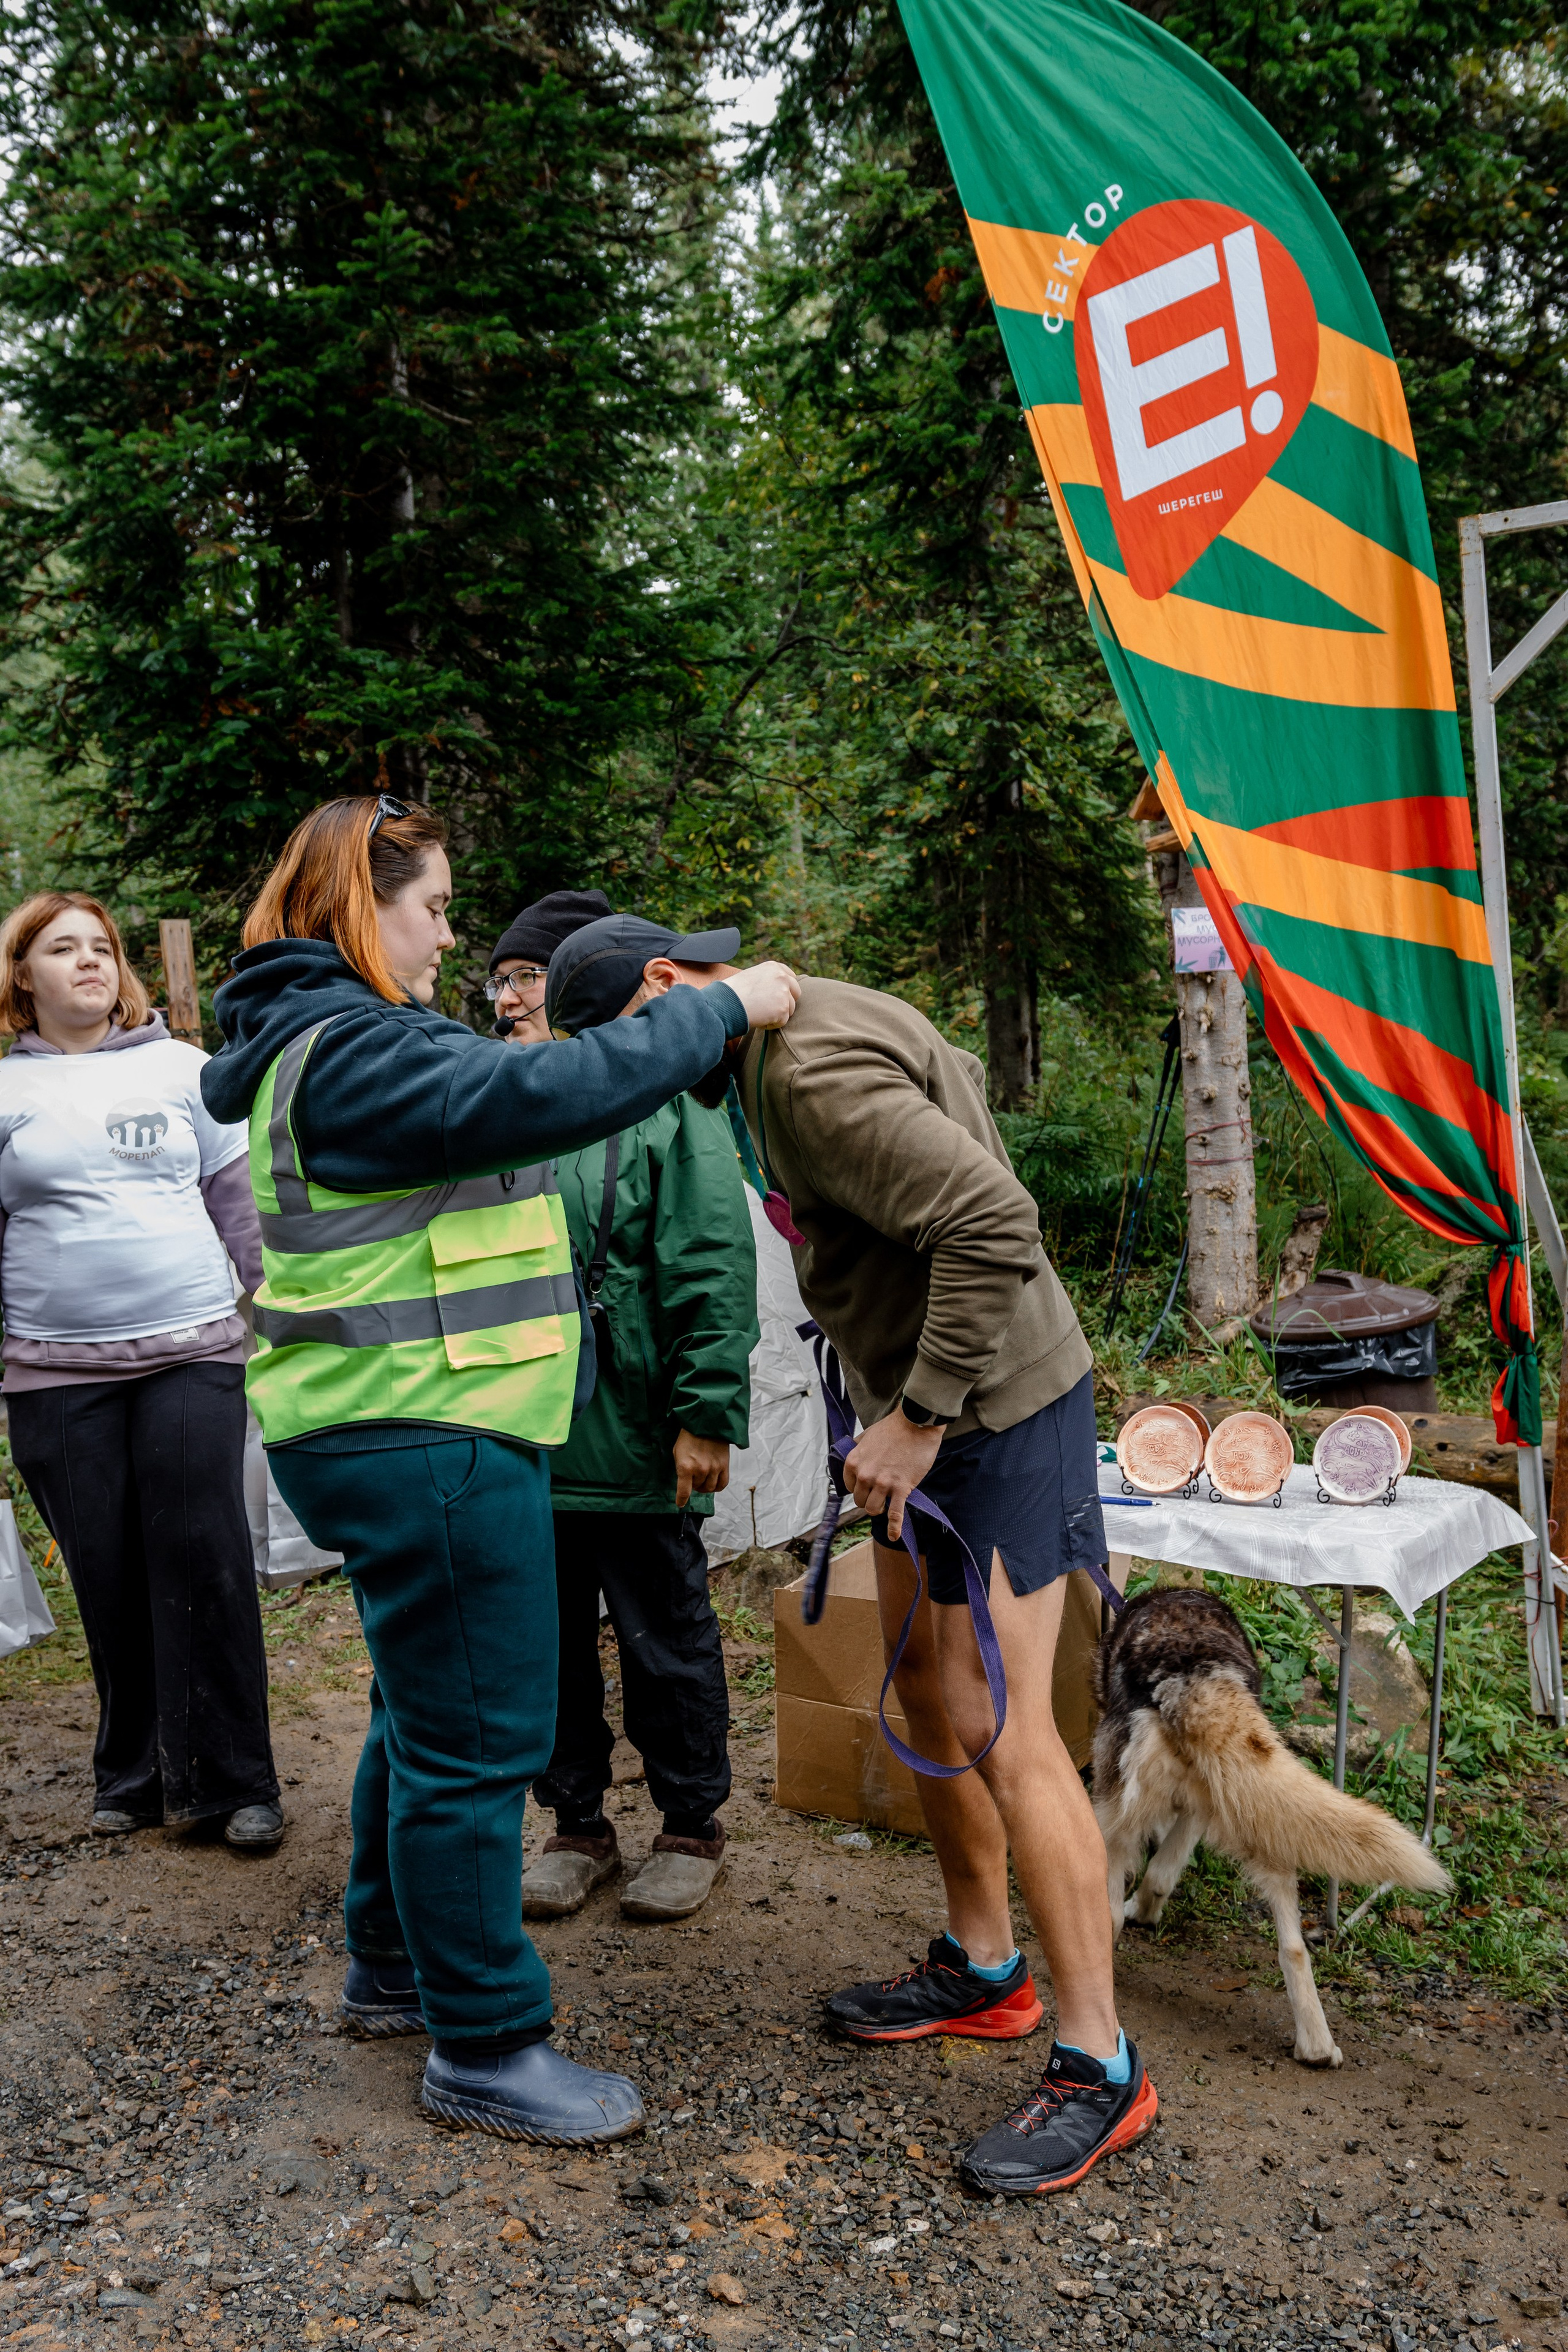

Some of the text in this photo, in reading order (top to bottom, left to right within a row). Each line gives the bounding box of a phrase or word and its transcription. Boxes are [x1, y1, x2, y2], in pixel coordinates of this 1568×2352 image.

[1042, 183, 1123, 334] СЕКТОР
[1158, 488, 1223, 514] ШЕРЕГЕШ
[1197, 925, 1216, 934] МУС
[1178, 936, 1220, 946] МУСОРН
[109, 1146, 165, 1161] МОРЕЛАП
